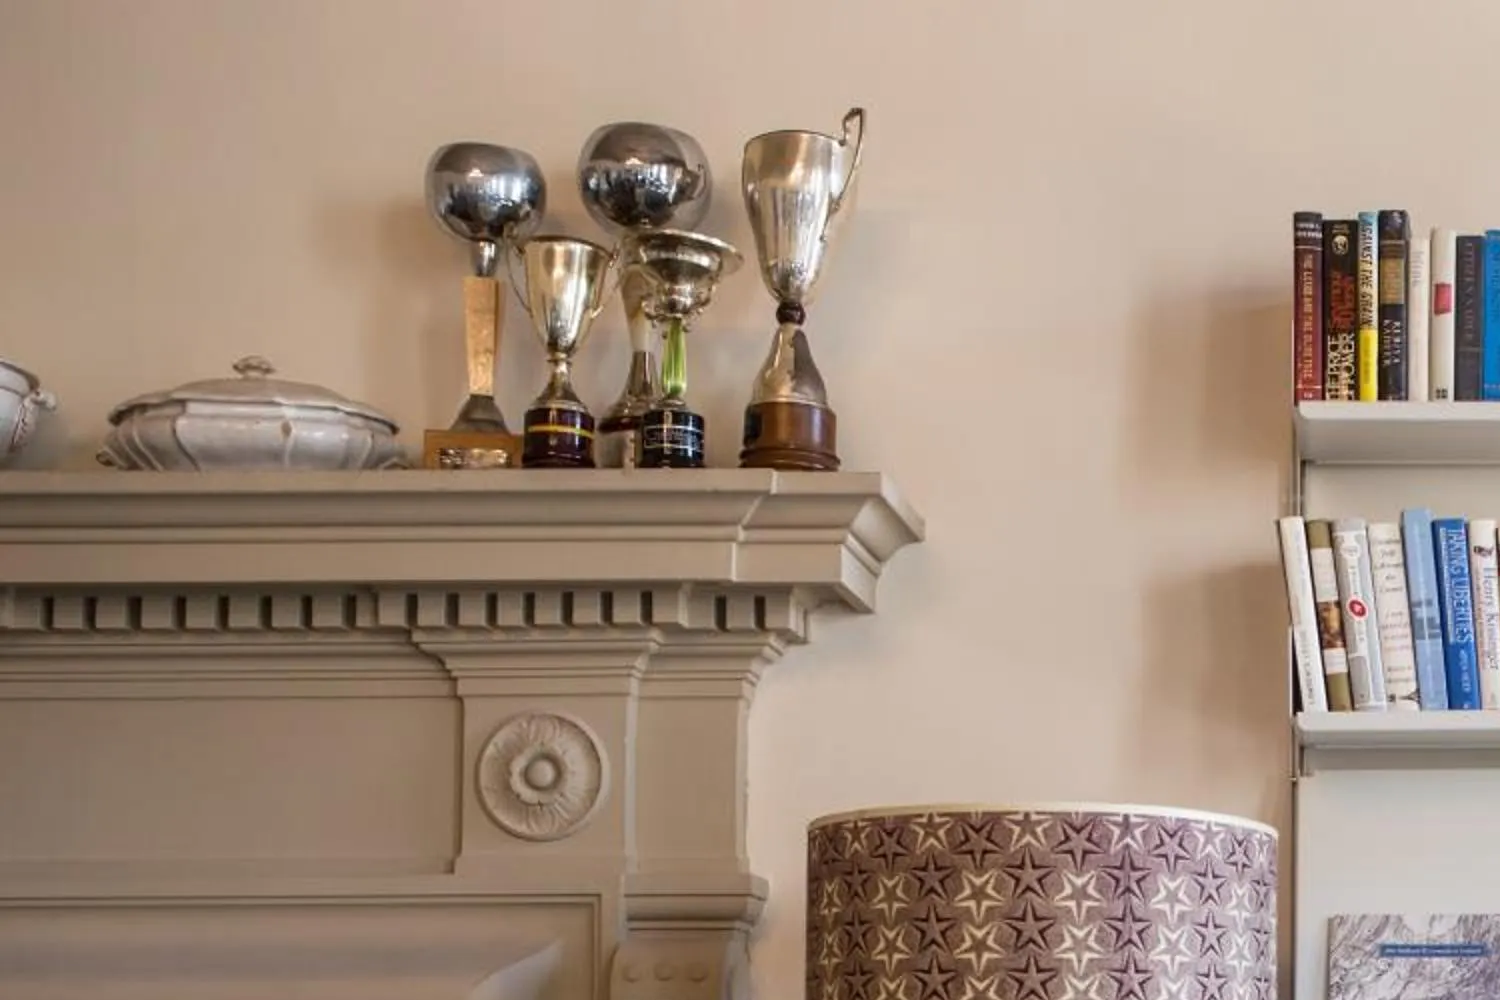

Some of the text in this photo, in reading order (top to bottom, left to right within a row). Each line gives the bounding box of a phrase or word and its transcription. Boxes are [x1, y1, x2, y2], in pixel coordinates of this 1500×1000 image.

[1362, 223, 1375, 266] AGAINST
[1361, 269, 1374, 289] THE
[1361, 292, 1374, 328] GRAIN
[1447, 528, 1471, 576] TAKING
[1482, 567, 1496, 609] Henry
[1452, 578, 1475, 644] LIBERTIES
